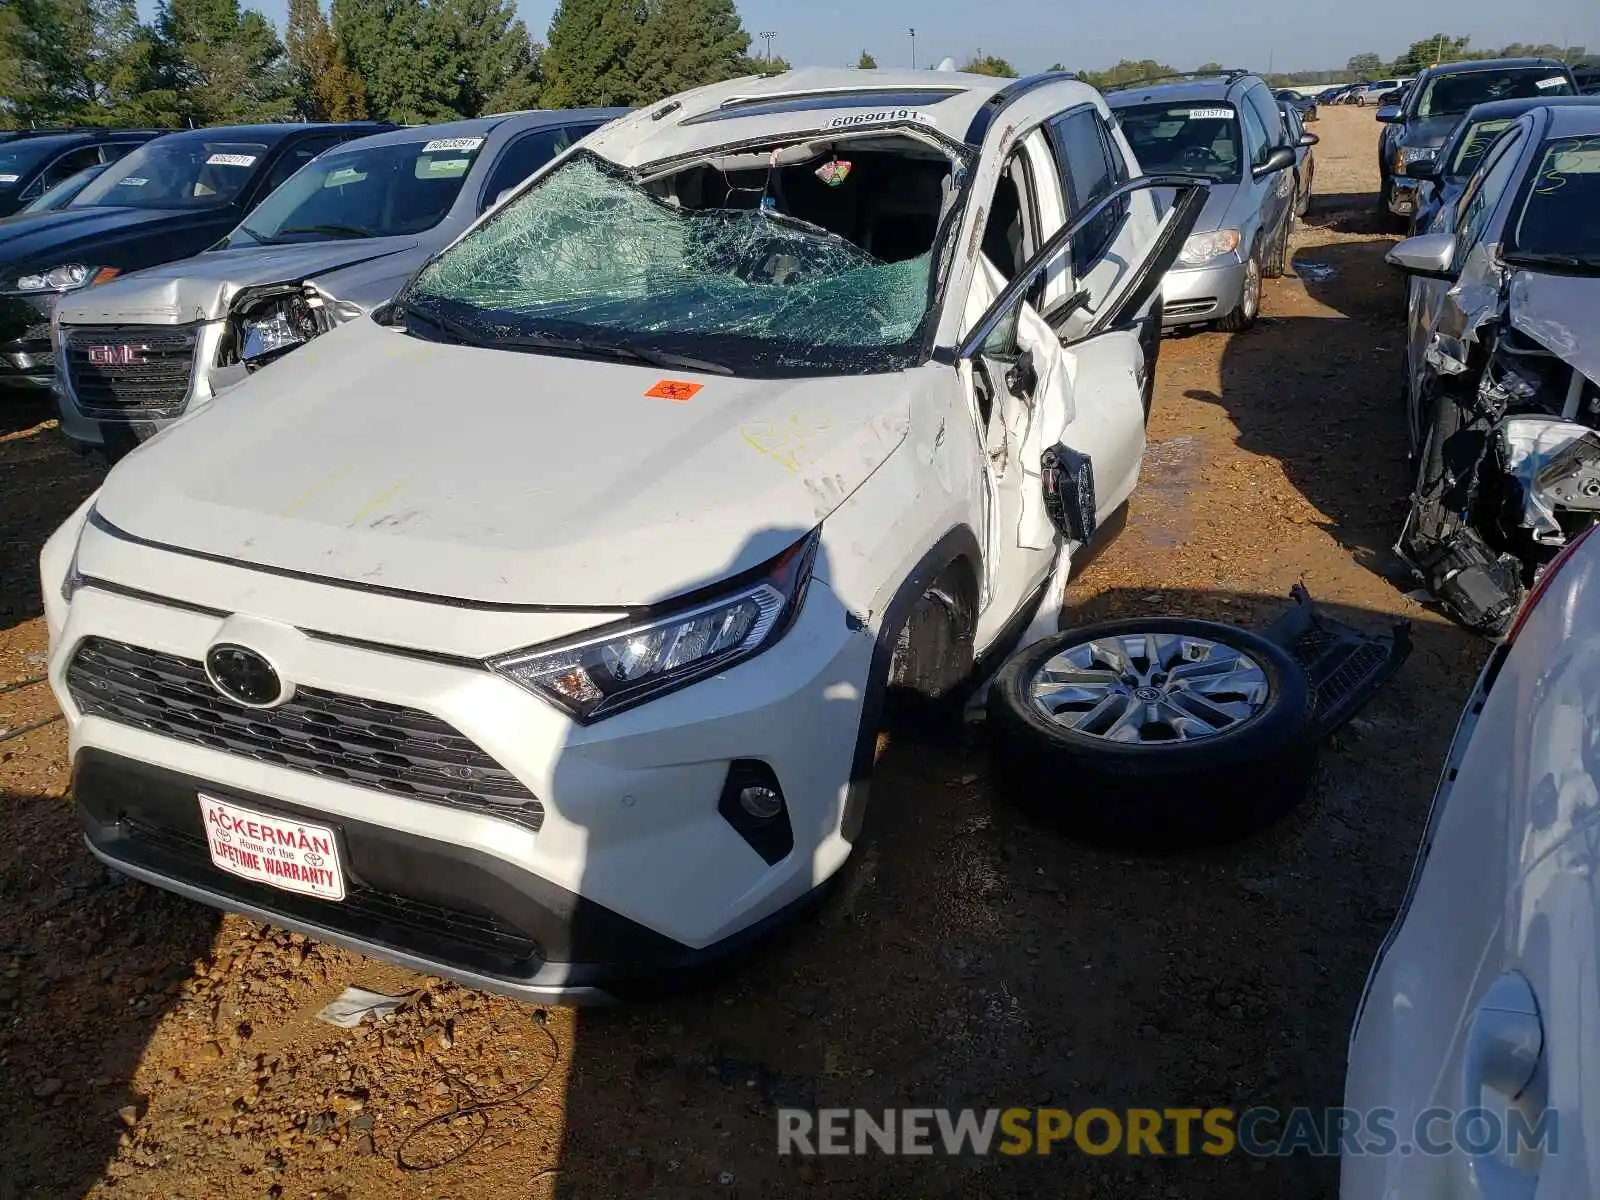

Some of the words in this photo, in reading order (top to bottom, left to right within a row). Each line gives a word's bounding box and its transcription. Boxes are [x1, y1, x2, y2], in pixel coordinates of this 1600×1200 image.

[831, 109, 918, 127] 60690191
[88, 344, 147, 364] GMC
[209, 808, 330, 855] ACKERMAN
[239, 837, 264, 853] Home
[267, 845, 276, 856] of
[278, 848, 295, 860] the
[212, 839, 261, 872] LIFETIME
[262, 856, 333, 887] WARRANTY
